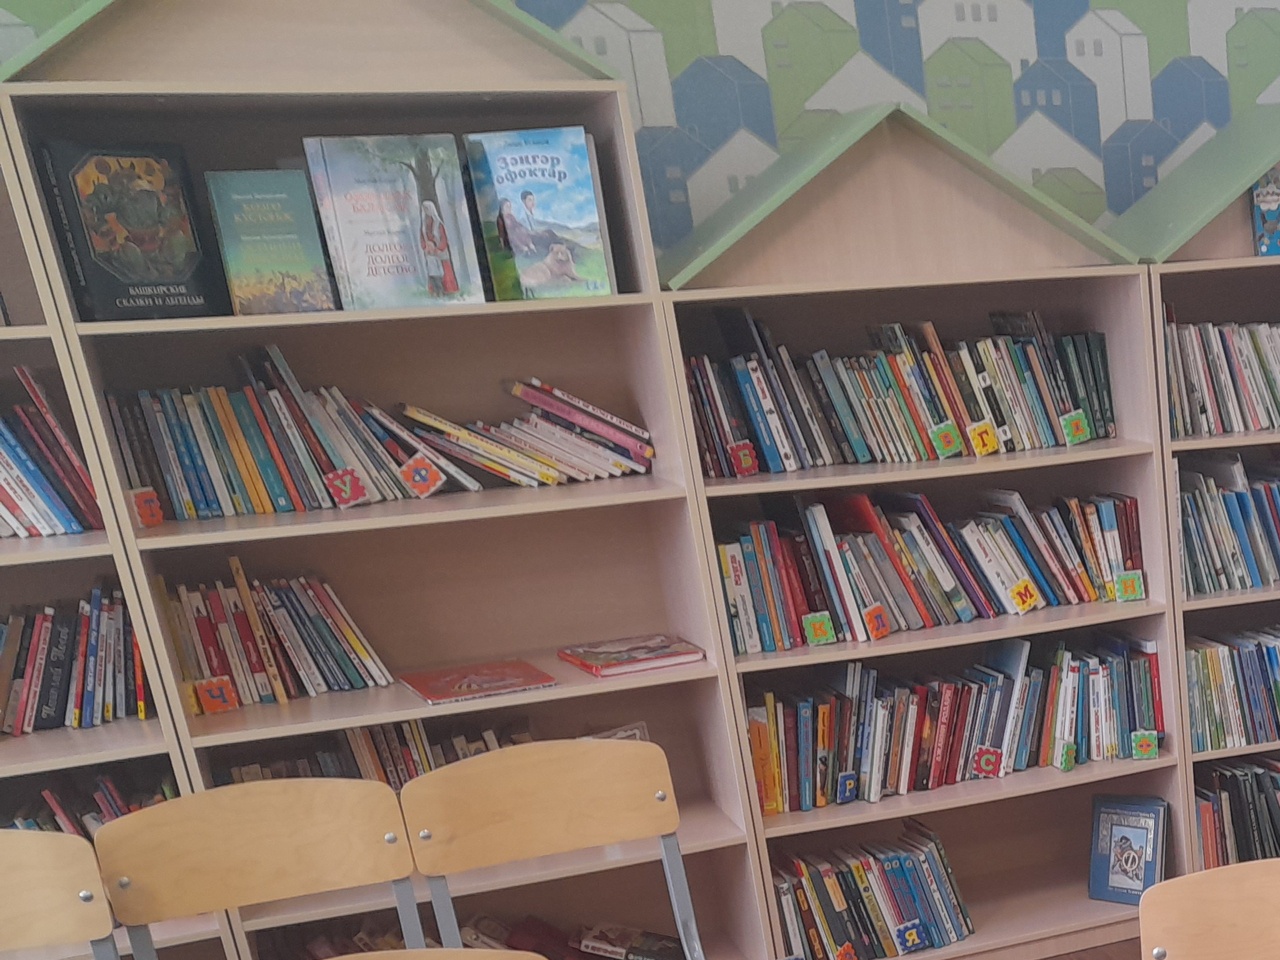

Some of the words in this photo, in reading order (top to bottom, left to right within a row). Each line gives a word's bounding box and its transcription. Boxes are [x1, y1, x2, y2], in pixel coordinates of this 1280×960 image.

[977, 428, 989, 448] Г
[738, 450, 753, 467] Б
[1016, 586, 1035, 605] М
[1122, 579, 1137, 595] Н
[810, 622, 829, 639] К
[980, 754, 995, 771] С
[845, 778, 856, 797] Р
[905, 929, 921, 947] Я
